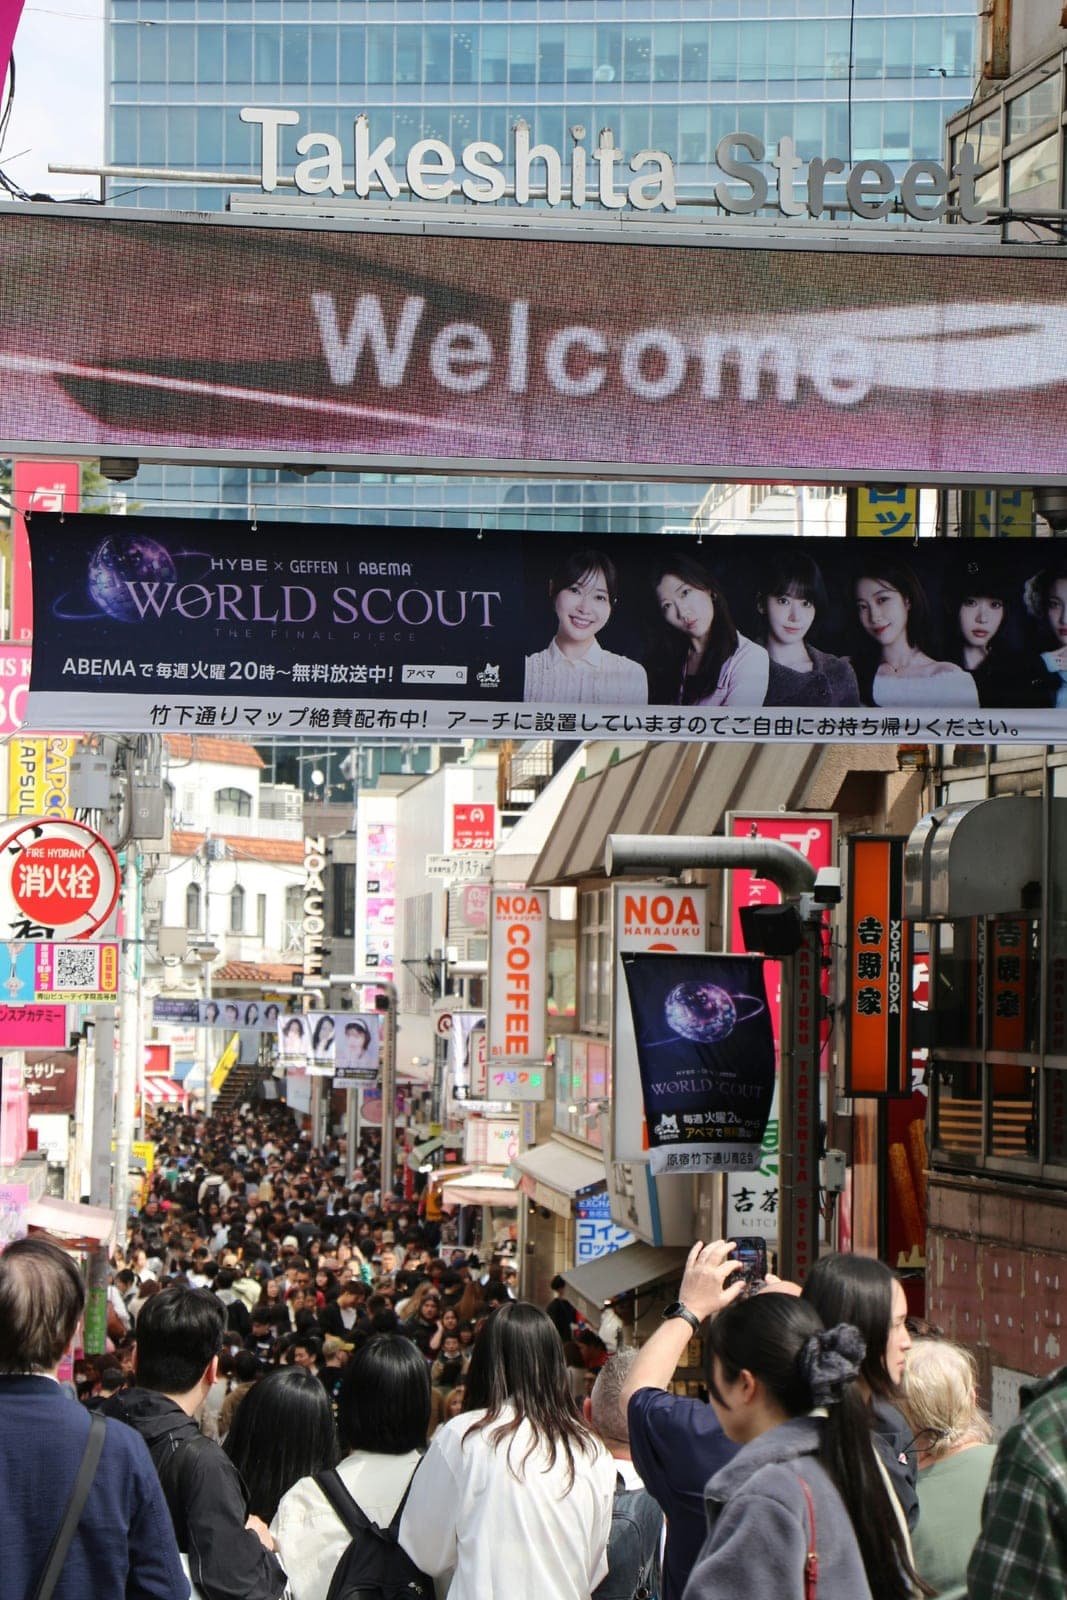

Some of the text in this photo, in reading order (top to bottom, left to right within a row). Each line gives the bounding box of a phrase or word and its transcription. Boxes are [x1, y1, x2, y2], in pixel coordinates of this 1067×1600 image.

[239, 107, 989, 224] Takeshita Street
[310, 291, 876, 406] Welcome
[210, 558, 268, 572] HYBE
[289, 559, 339, 575] GEFFEN
[358, 561, 412, 577] ABEMA
[125, 582, 502, 627] WORLD SCOUT
[214, 628, 416, 642] THE FINAL PIECE
[406, 669, 436, 679] アベマ
[26, 848, 87, 859] FIRE HYDRANT
[18, 863, 95, 899] 消火栓
[496, 896, 542, 915] NOA
[624, 895, 699, 925] NOA
[623, 927, 701, 937] HARAJUKU
[857, 915, 883, 1016] 吉野家
[506, 923, 531, 1056] COFFEE
[651, 1078, 765, 1098] WORLD COUT
